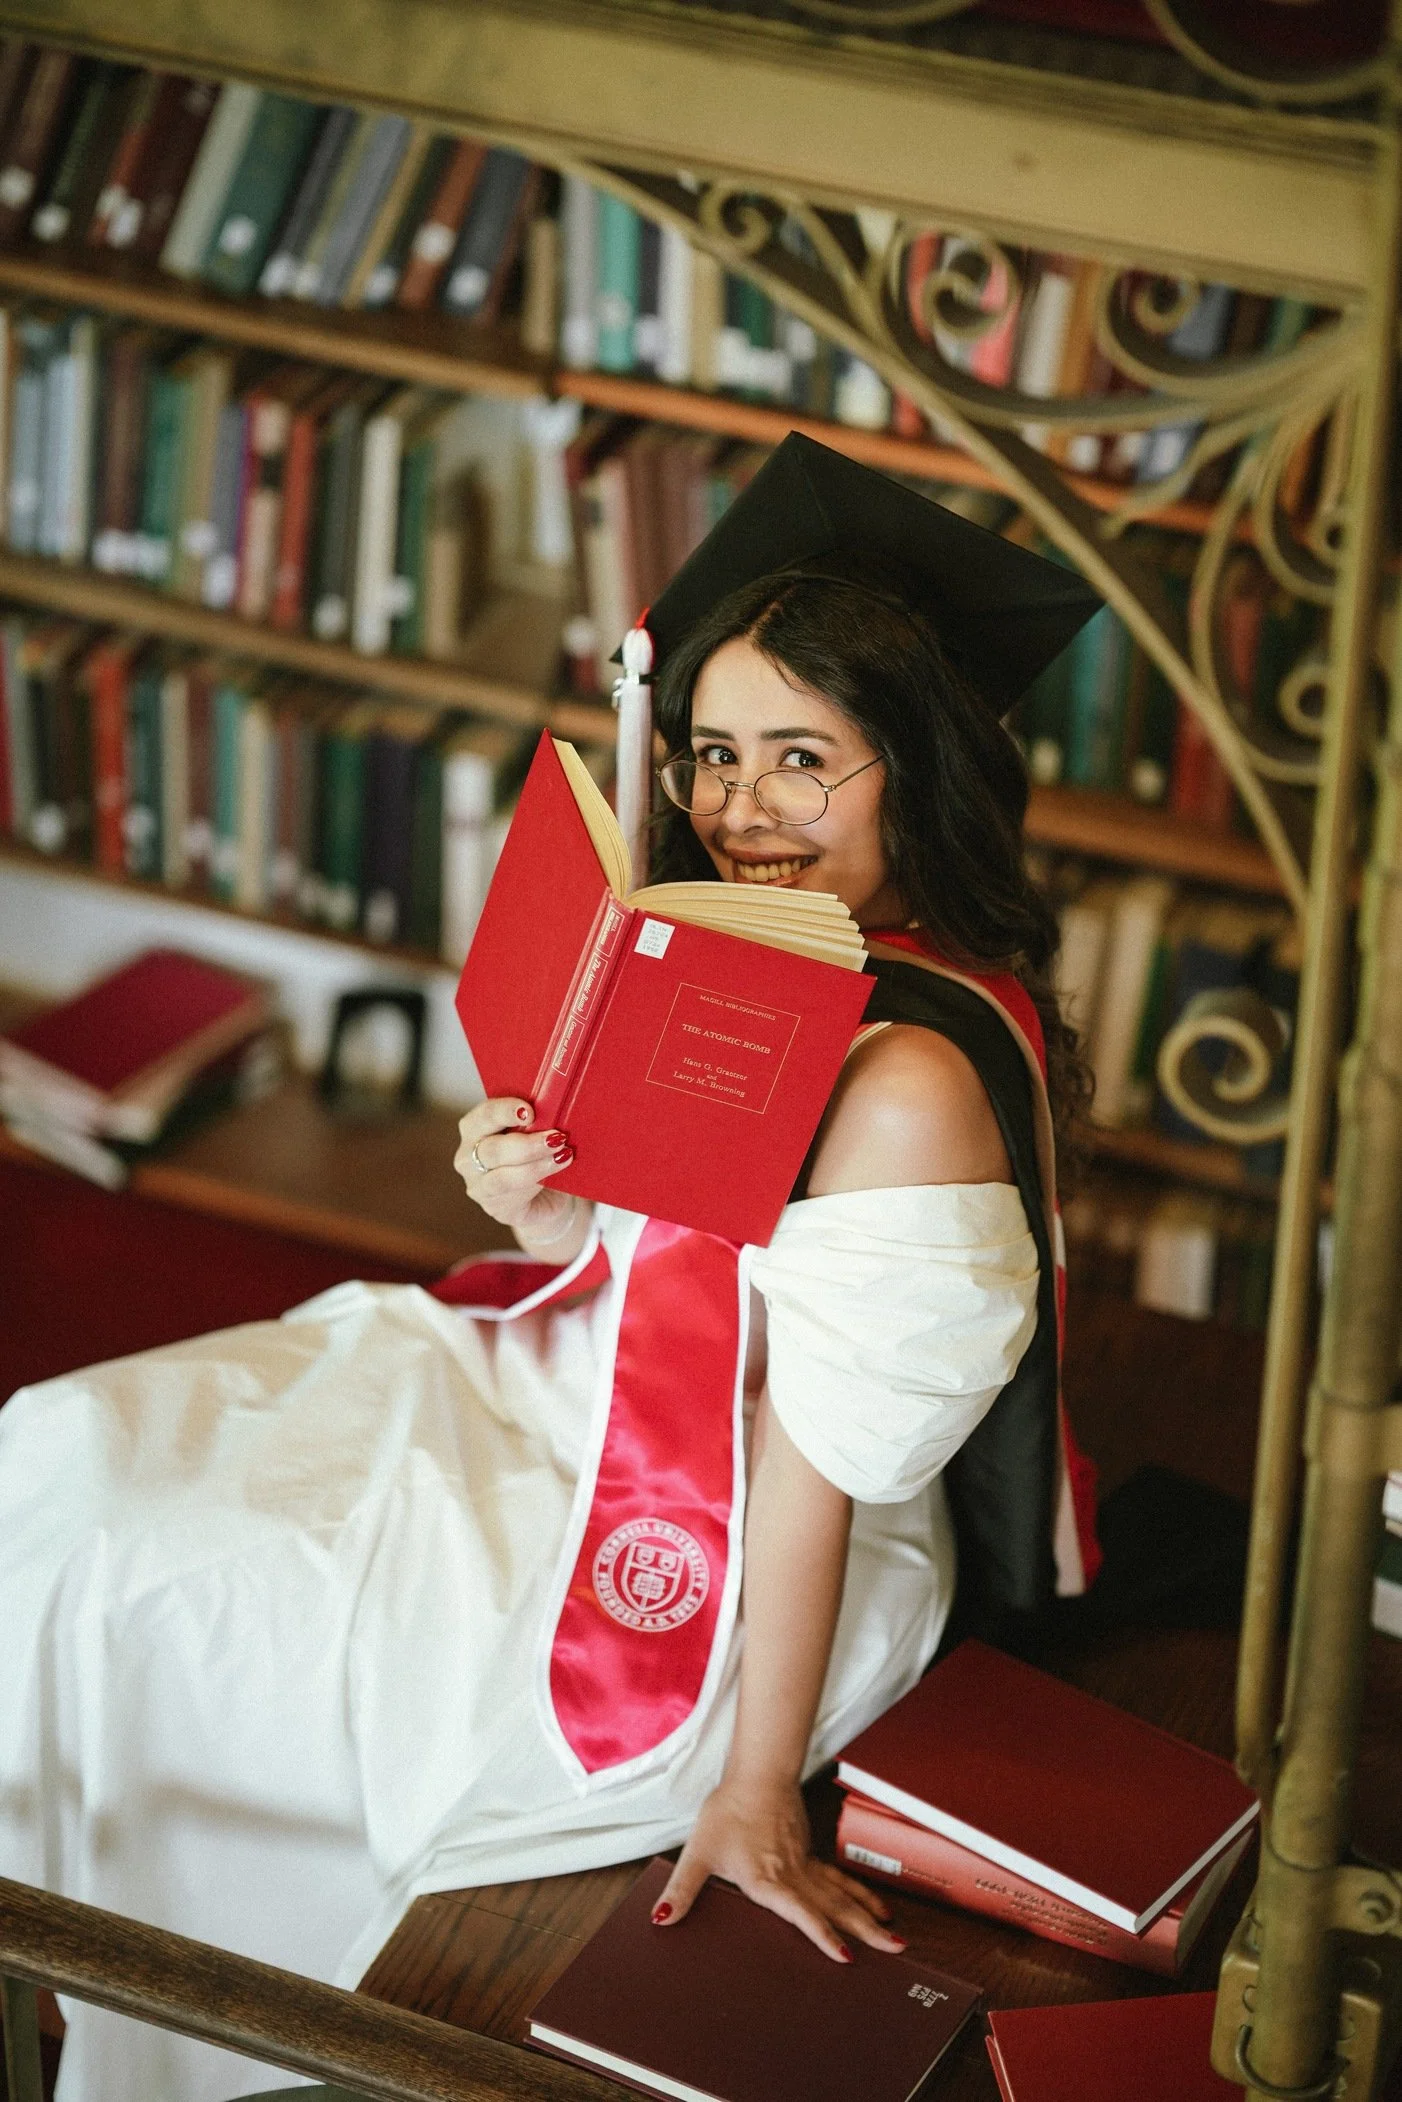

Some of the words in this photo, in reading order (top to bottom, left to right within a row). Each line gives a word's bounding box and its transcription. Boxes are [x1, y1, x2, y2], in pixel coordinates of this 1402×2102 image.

[590, 958, 602, 973] The
[583, 971, 596, 994] Atomic
[577, 995, 589, 1012] Bomb
[699, 994, 724, 1007] MAGILL
[725, 1001, 777, 1021] BIBLIOGRAPHIES
[682, 1023, 702, 1035] THE
[702, 1030, 742, 1046] ATOMIC
[742, 1040, 771, 1054] BOMB
[673, 1070, 695, 1084] Larry
[696, 1077, 707, 1087] M.
[709, 1081, 746, 1098] Browning
[706, 1073, 718, 1081] and
[598, 1522, 650, 1565] CORNELL
